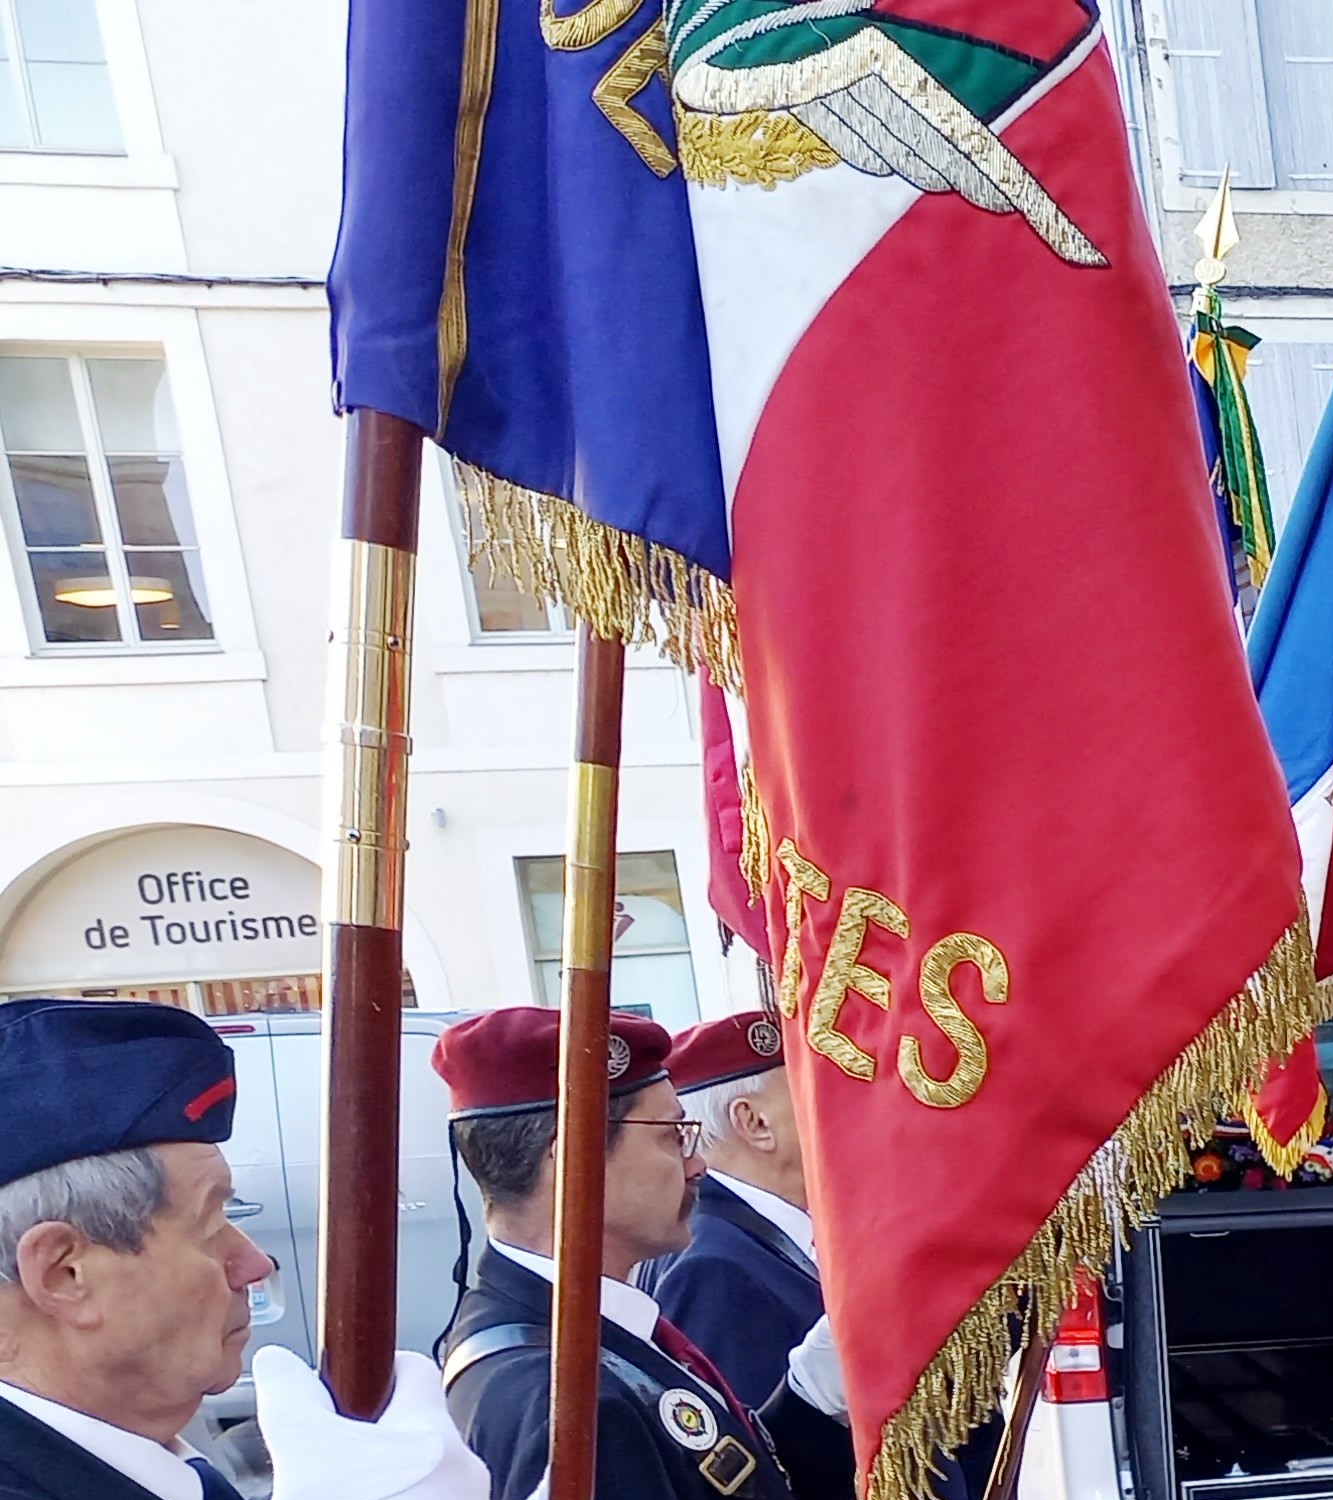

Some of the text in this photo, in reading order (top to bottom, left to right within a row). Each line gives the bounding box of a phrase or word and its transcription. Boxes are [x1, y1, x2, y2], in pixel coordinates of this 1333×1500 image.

[137, 871, 250, 905] Office
[85, 911, 318, 950] de Tourisme
[775, 836, 1010, 1109] TES
